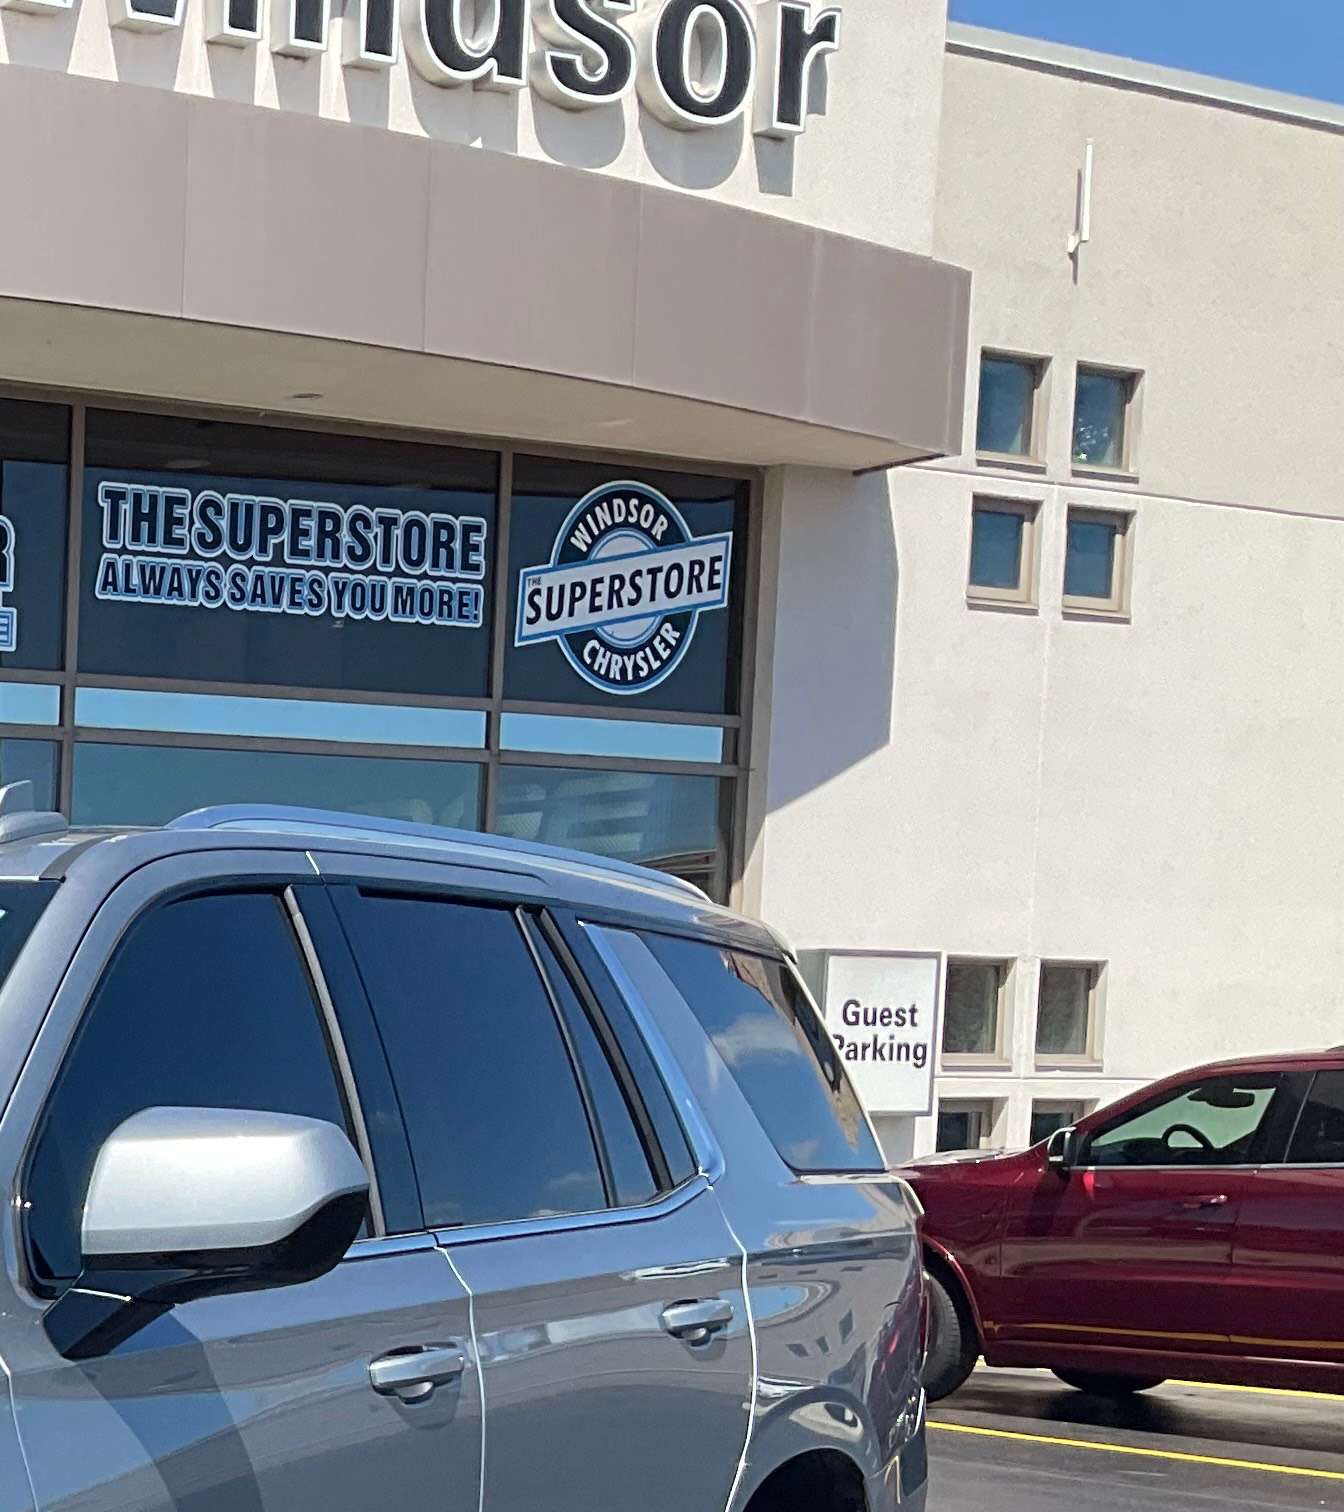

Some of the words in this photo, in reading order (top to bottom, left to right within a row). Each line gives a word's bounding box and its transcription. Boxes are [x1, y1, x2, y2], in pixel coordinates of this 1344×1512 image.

[102, 487, 189, 552] THE
[192, 495, 487, 577] SUPERSTORE
[570, 498, 669, 552] WINDSOR
[100, 560, 224, 603] ALWAYS
[229, 570, 327, 612] SAVES
[331, 579, 389, 620] YOU
[392, 583, 481, 625] MORE!
[526, 555, 723, 625] SUPERSTORE
[527, 575, 543, 587] THE
[583, 622, 681, 681] CHRYSLER
[841, 998, 919, 1028] Guest
